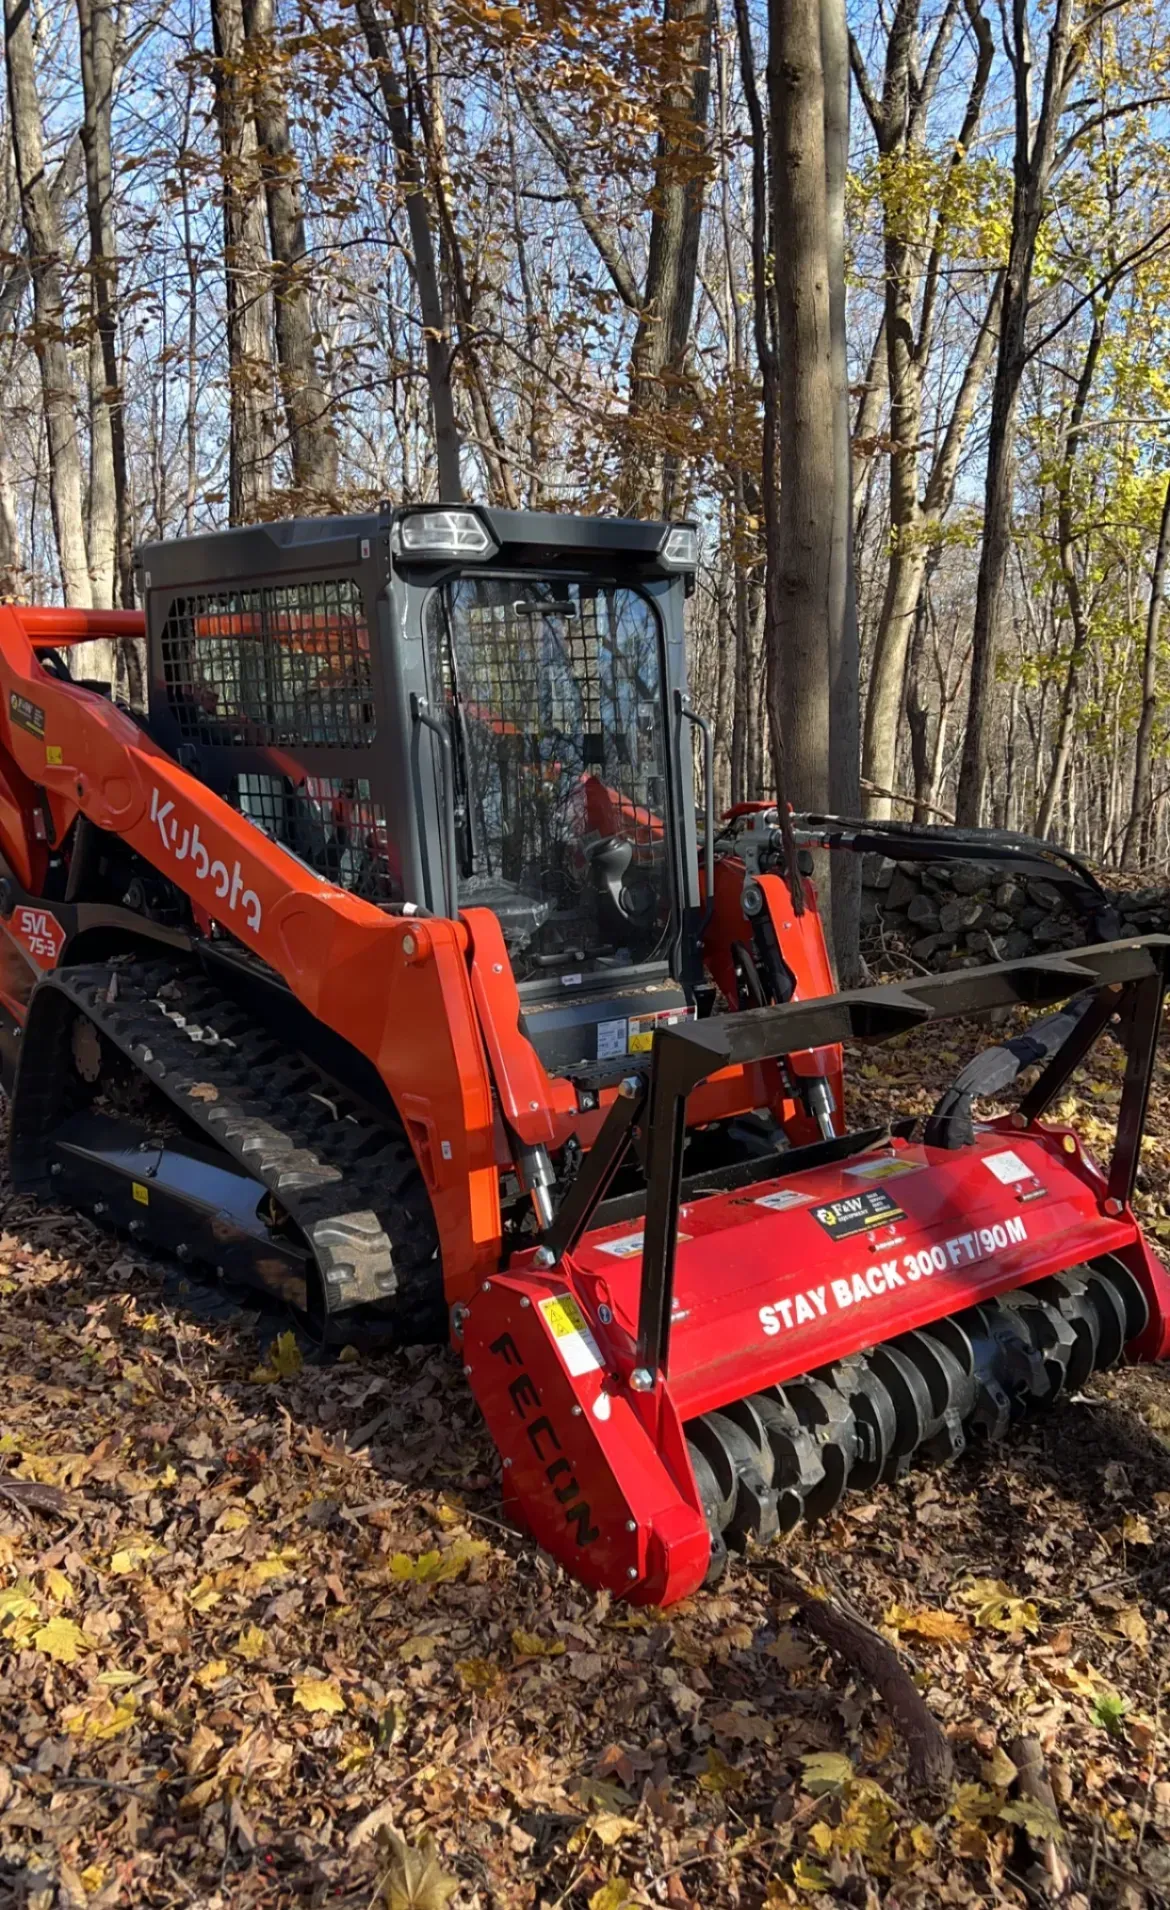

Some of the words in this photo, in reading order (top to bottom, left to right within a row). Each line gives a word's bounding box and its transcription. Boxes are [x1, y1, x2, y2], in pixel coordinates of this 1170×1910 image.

[150, 787, 262, 934] Kubota
[21, 911, 53, 938] SVL
[28, 935, 56, 958] 75-3
[831, 1197, 863, 1217] F&W
[758, 1283, 829, 1337] STAY
[831, 1260, 906, 1309] BACK
[903, 1246, 948, 1282] 300
[488, 1331, 601, 1547] FECON
